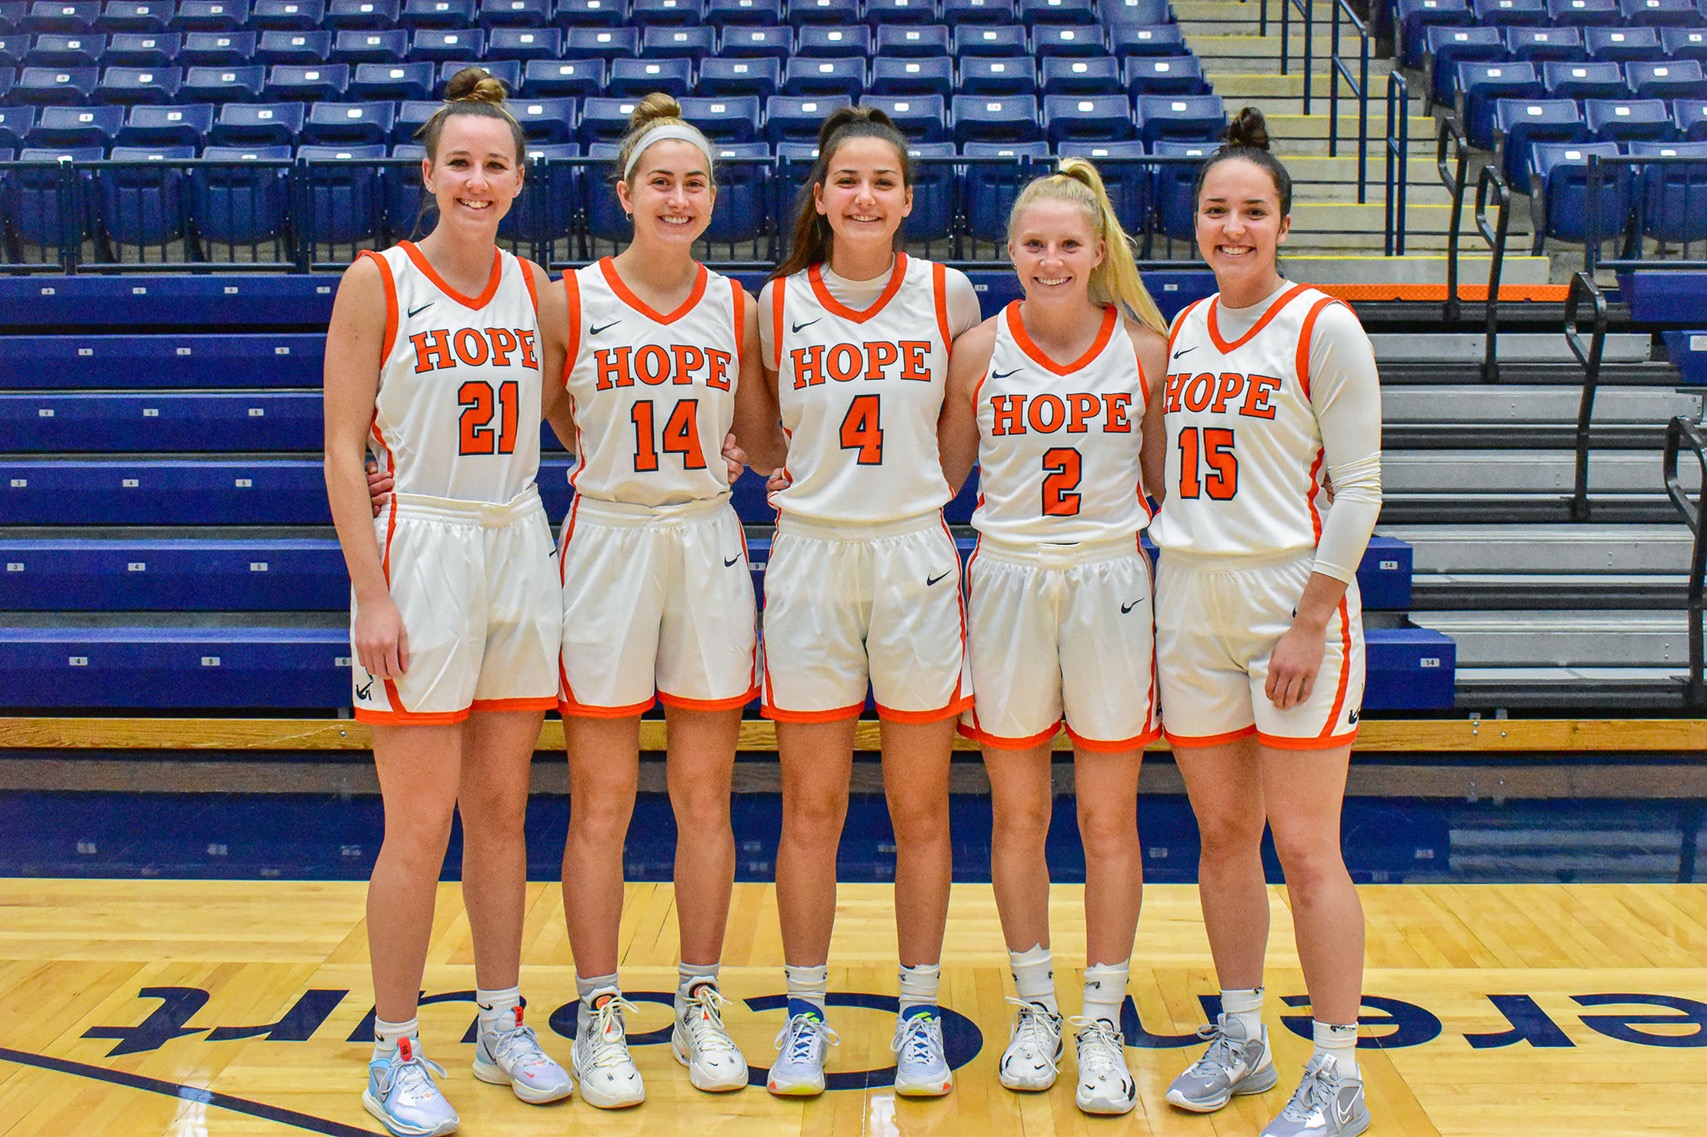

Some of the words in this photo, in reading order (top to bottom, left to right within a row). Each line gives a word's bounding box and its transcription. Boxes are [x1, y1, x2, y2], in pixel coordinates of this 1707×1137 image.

[409, 327, 539, 374] HOPE
[594, 346, 733, 392] HOPE
[790, 340, 932, 390] HOPE
[457, 380, 519, 456] 21
[838, 393, 884, 466] 4
[990, 392, 1132, 438] HOPE
[1164, 371, 1282, 421] HOPE
[631, 398, 708, 473] 14
[1177, 426, 1239, 502] 15
[1041, 446, 1083, 517] 2
[80, 986, 984, 1091] Court
